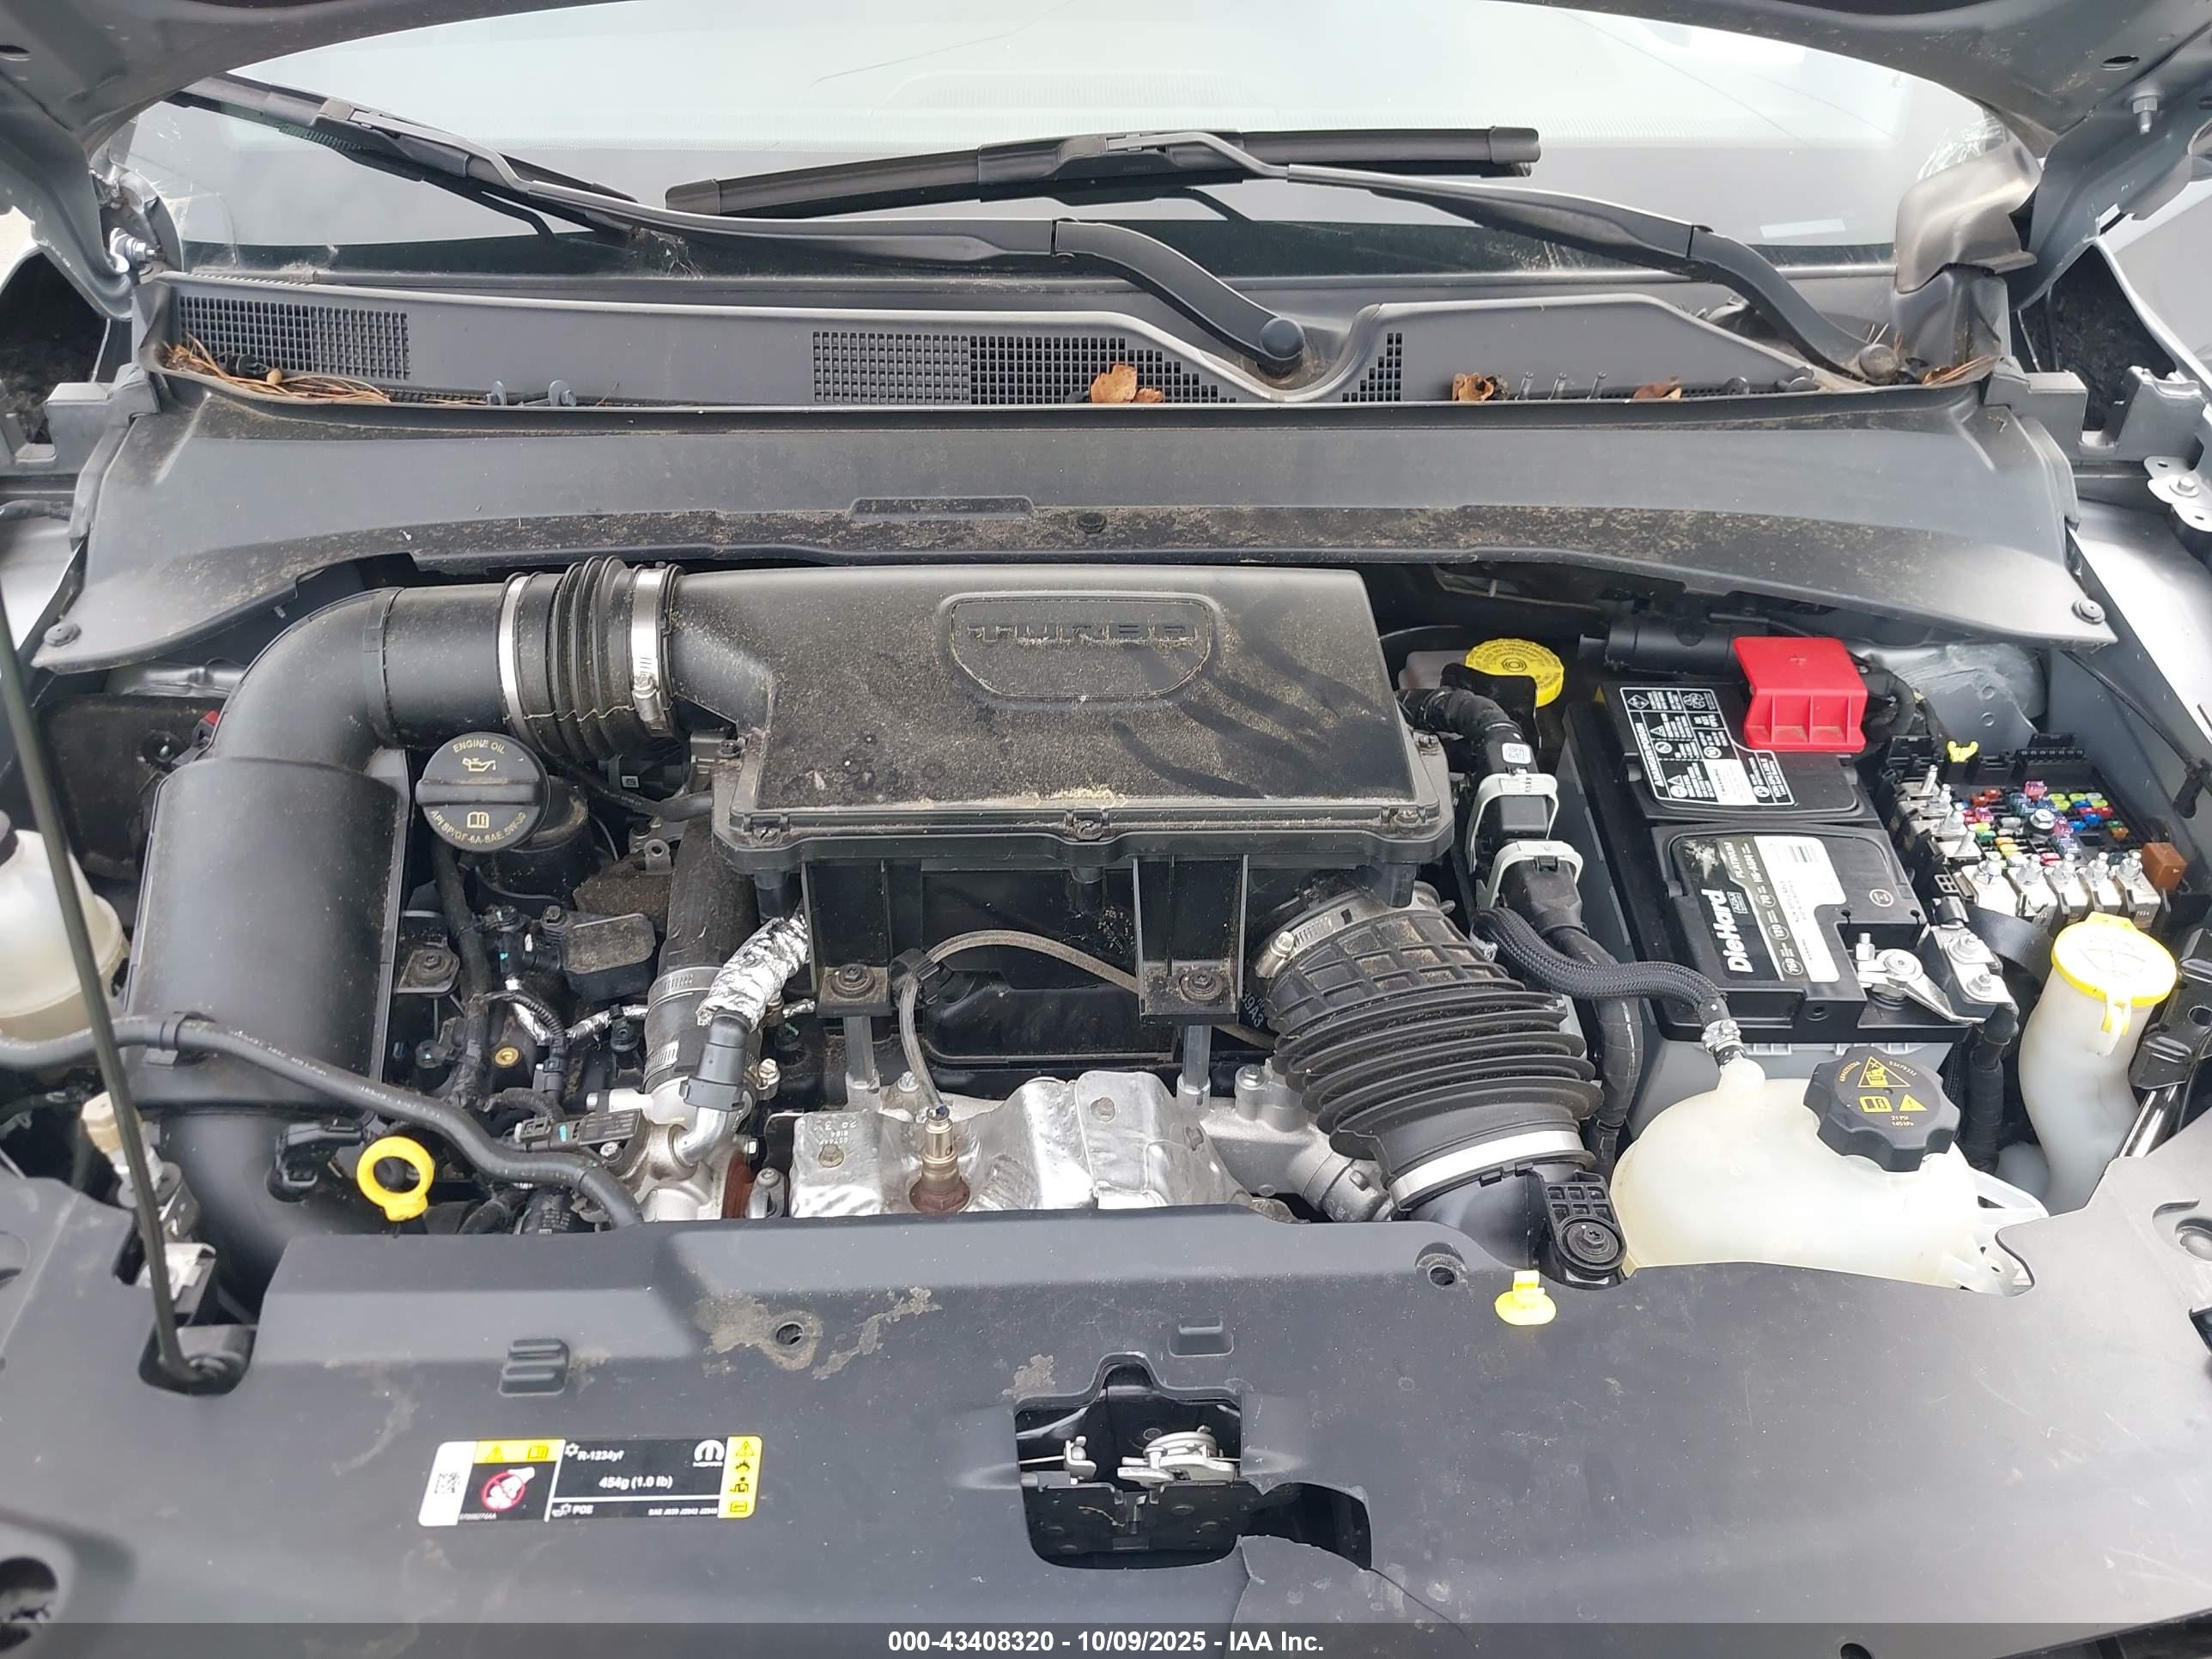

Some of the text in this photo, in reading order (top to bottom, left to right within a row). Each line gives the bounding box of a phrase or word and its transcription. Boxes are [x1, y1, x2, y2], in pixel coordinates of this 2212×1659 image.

[453, 739, 506, 754] ENGINE OIL
[430, 809, 443, 826] API
[1723, 842, 1746, 878] PLATINUM
[1701, 888, 1753, 973] DieHard
[576, 1449, 625, 1462] R-1234yf
[599, 1475, 673, 1491] 454g (1.0 lb)
[572, 1504, 594, 1516] POE
